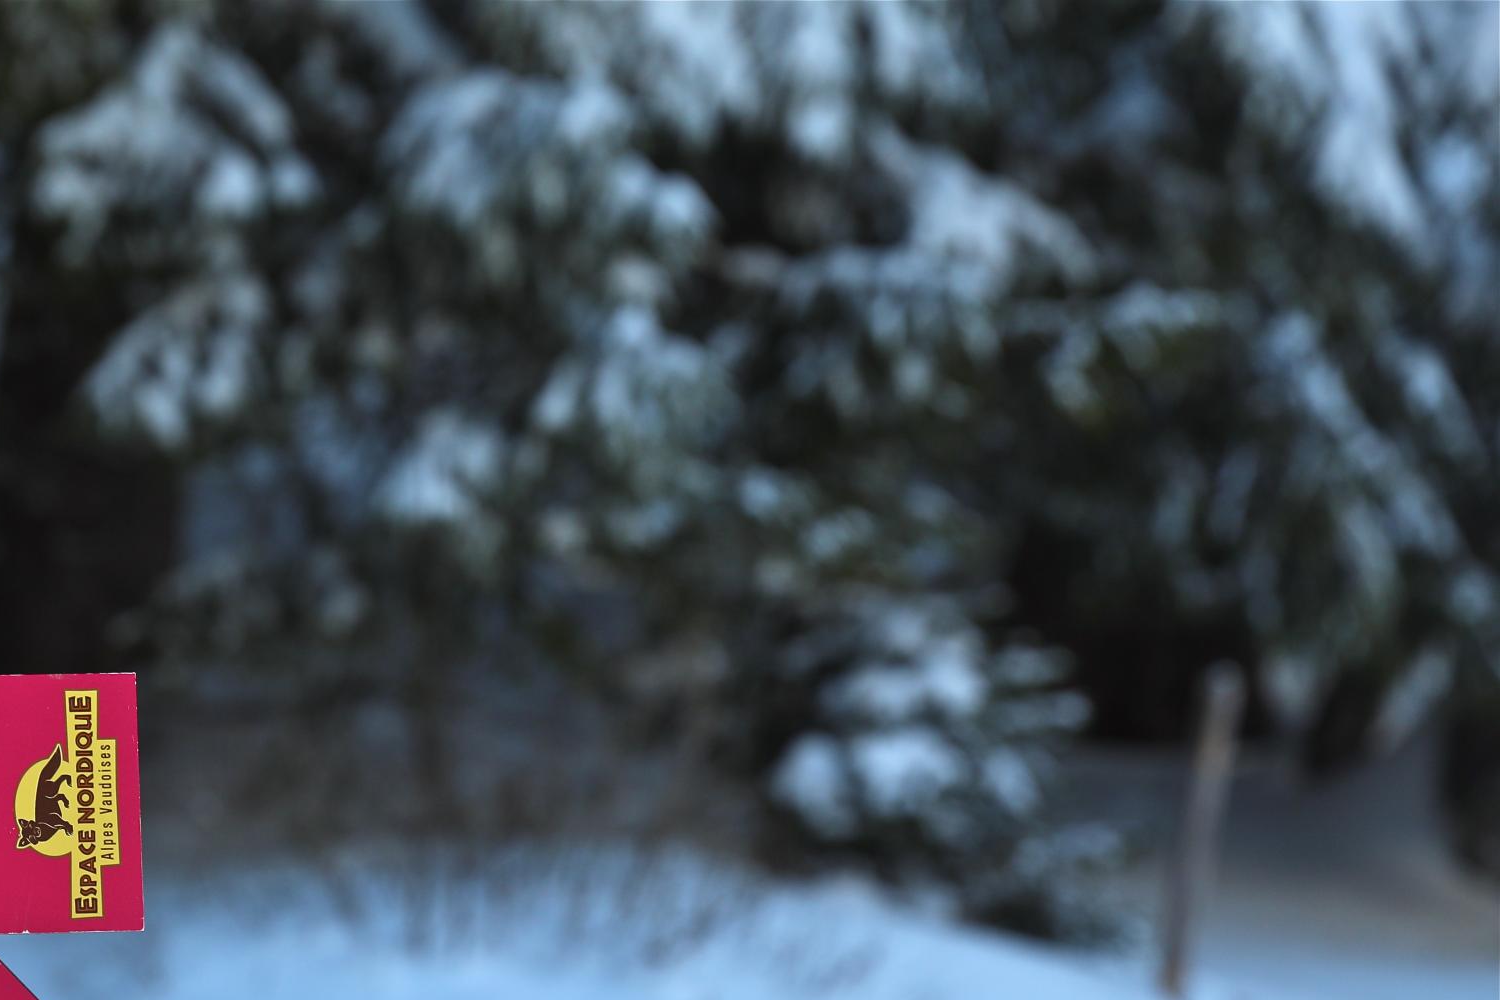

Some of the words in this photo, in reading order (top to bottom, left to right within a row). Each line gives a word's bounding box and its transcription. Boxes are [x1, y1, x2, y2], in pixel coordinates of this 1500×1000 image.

[68, 695, 96, 824] NORDIQUE
[98, 744, 113, 815] Vaudoises
[74, 829, 98, 914] ESPACE
[100, 822, 116, 860] Alpes
